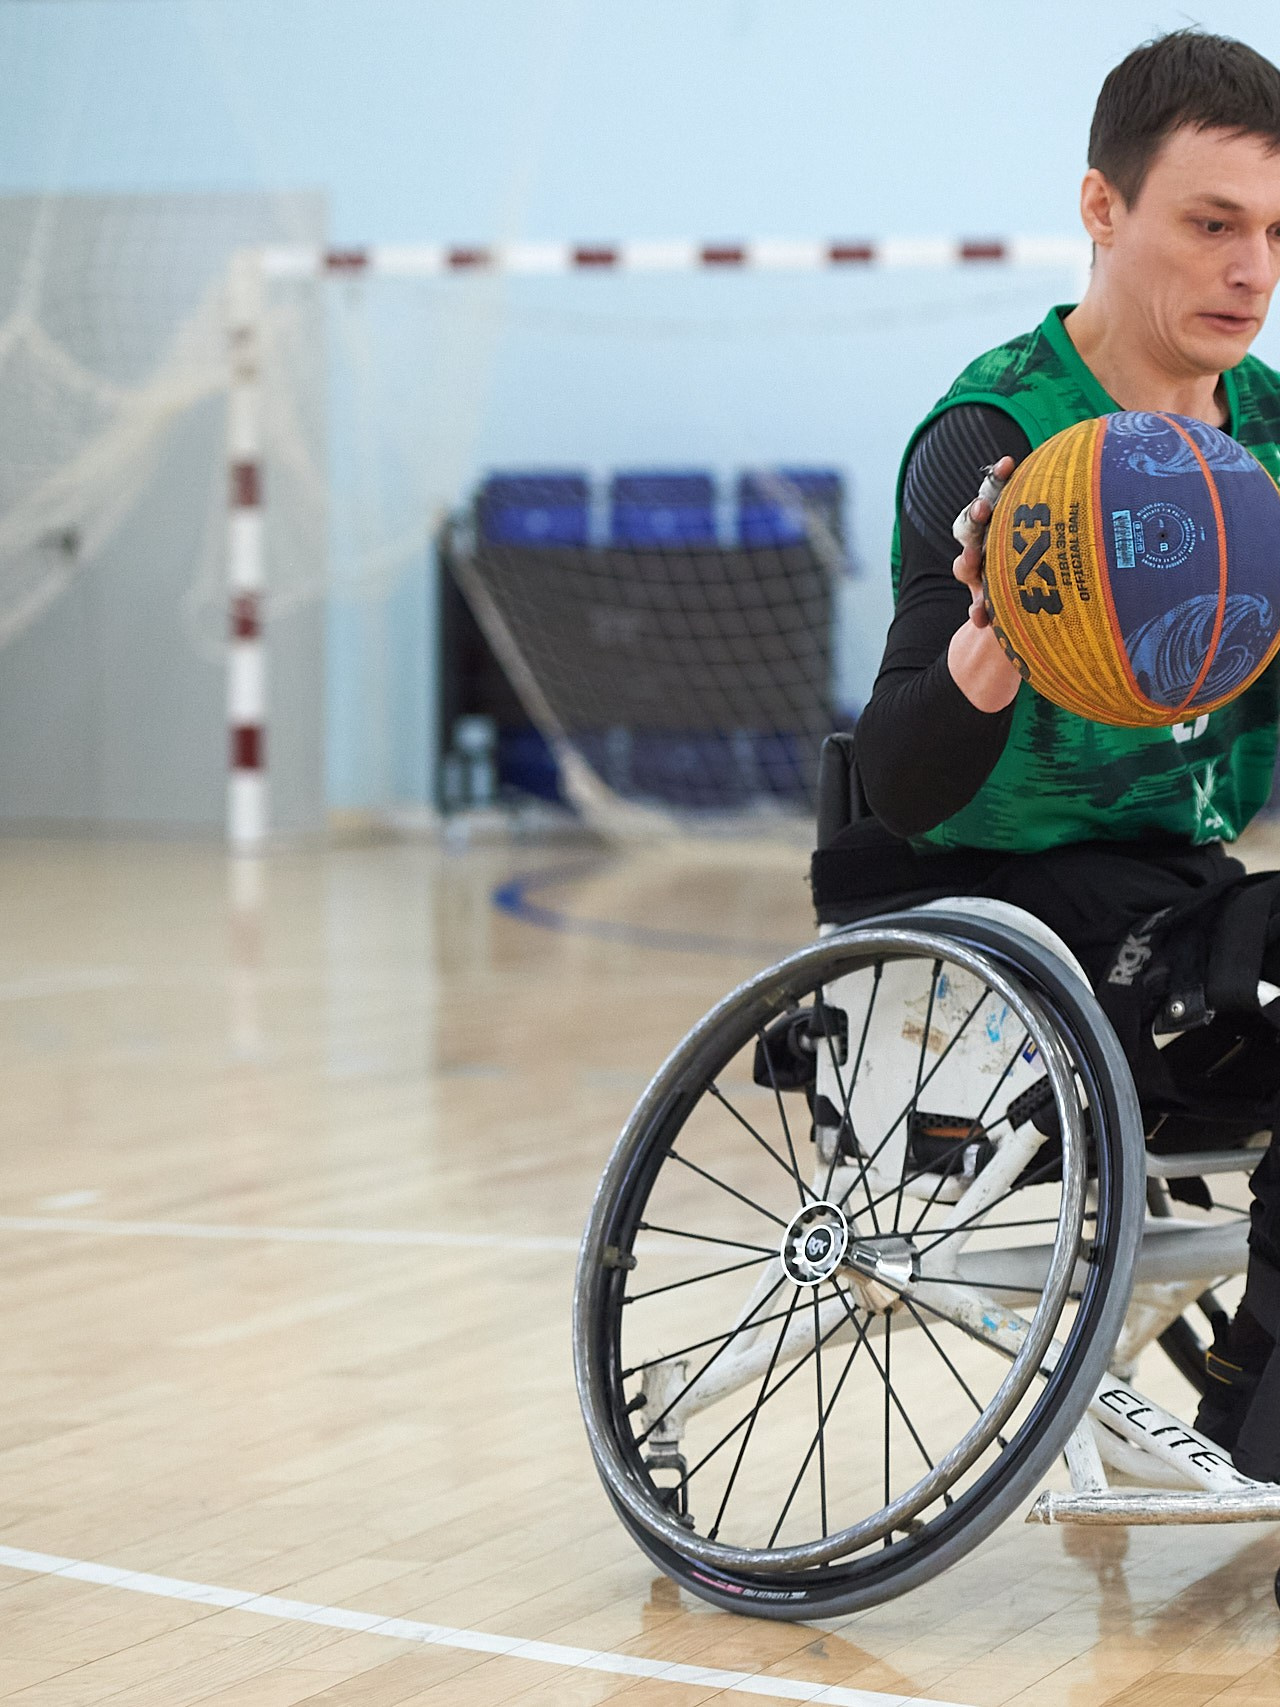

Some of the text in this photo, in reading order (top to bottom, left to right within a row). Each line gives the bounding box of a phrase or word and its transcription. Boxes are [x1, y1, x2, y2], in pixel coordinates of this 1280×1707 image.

[1057, 551, 1073, 587] FIBA
[1068, 502, 1091, 602] OFFICIAL BALL
[1098, 1389, 1238, 1473] ELITE
